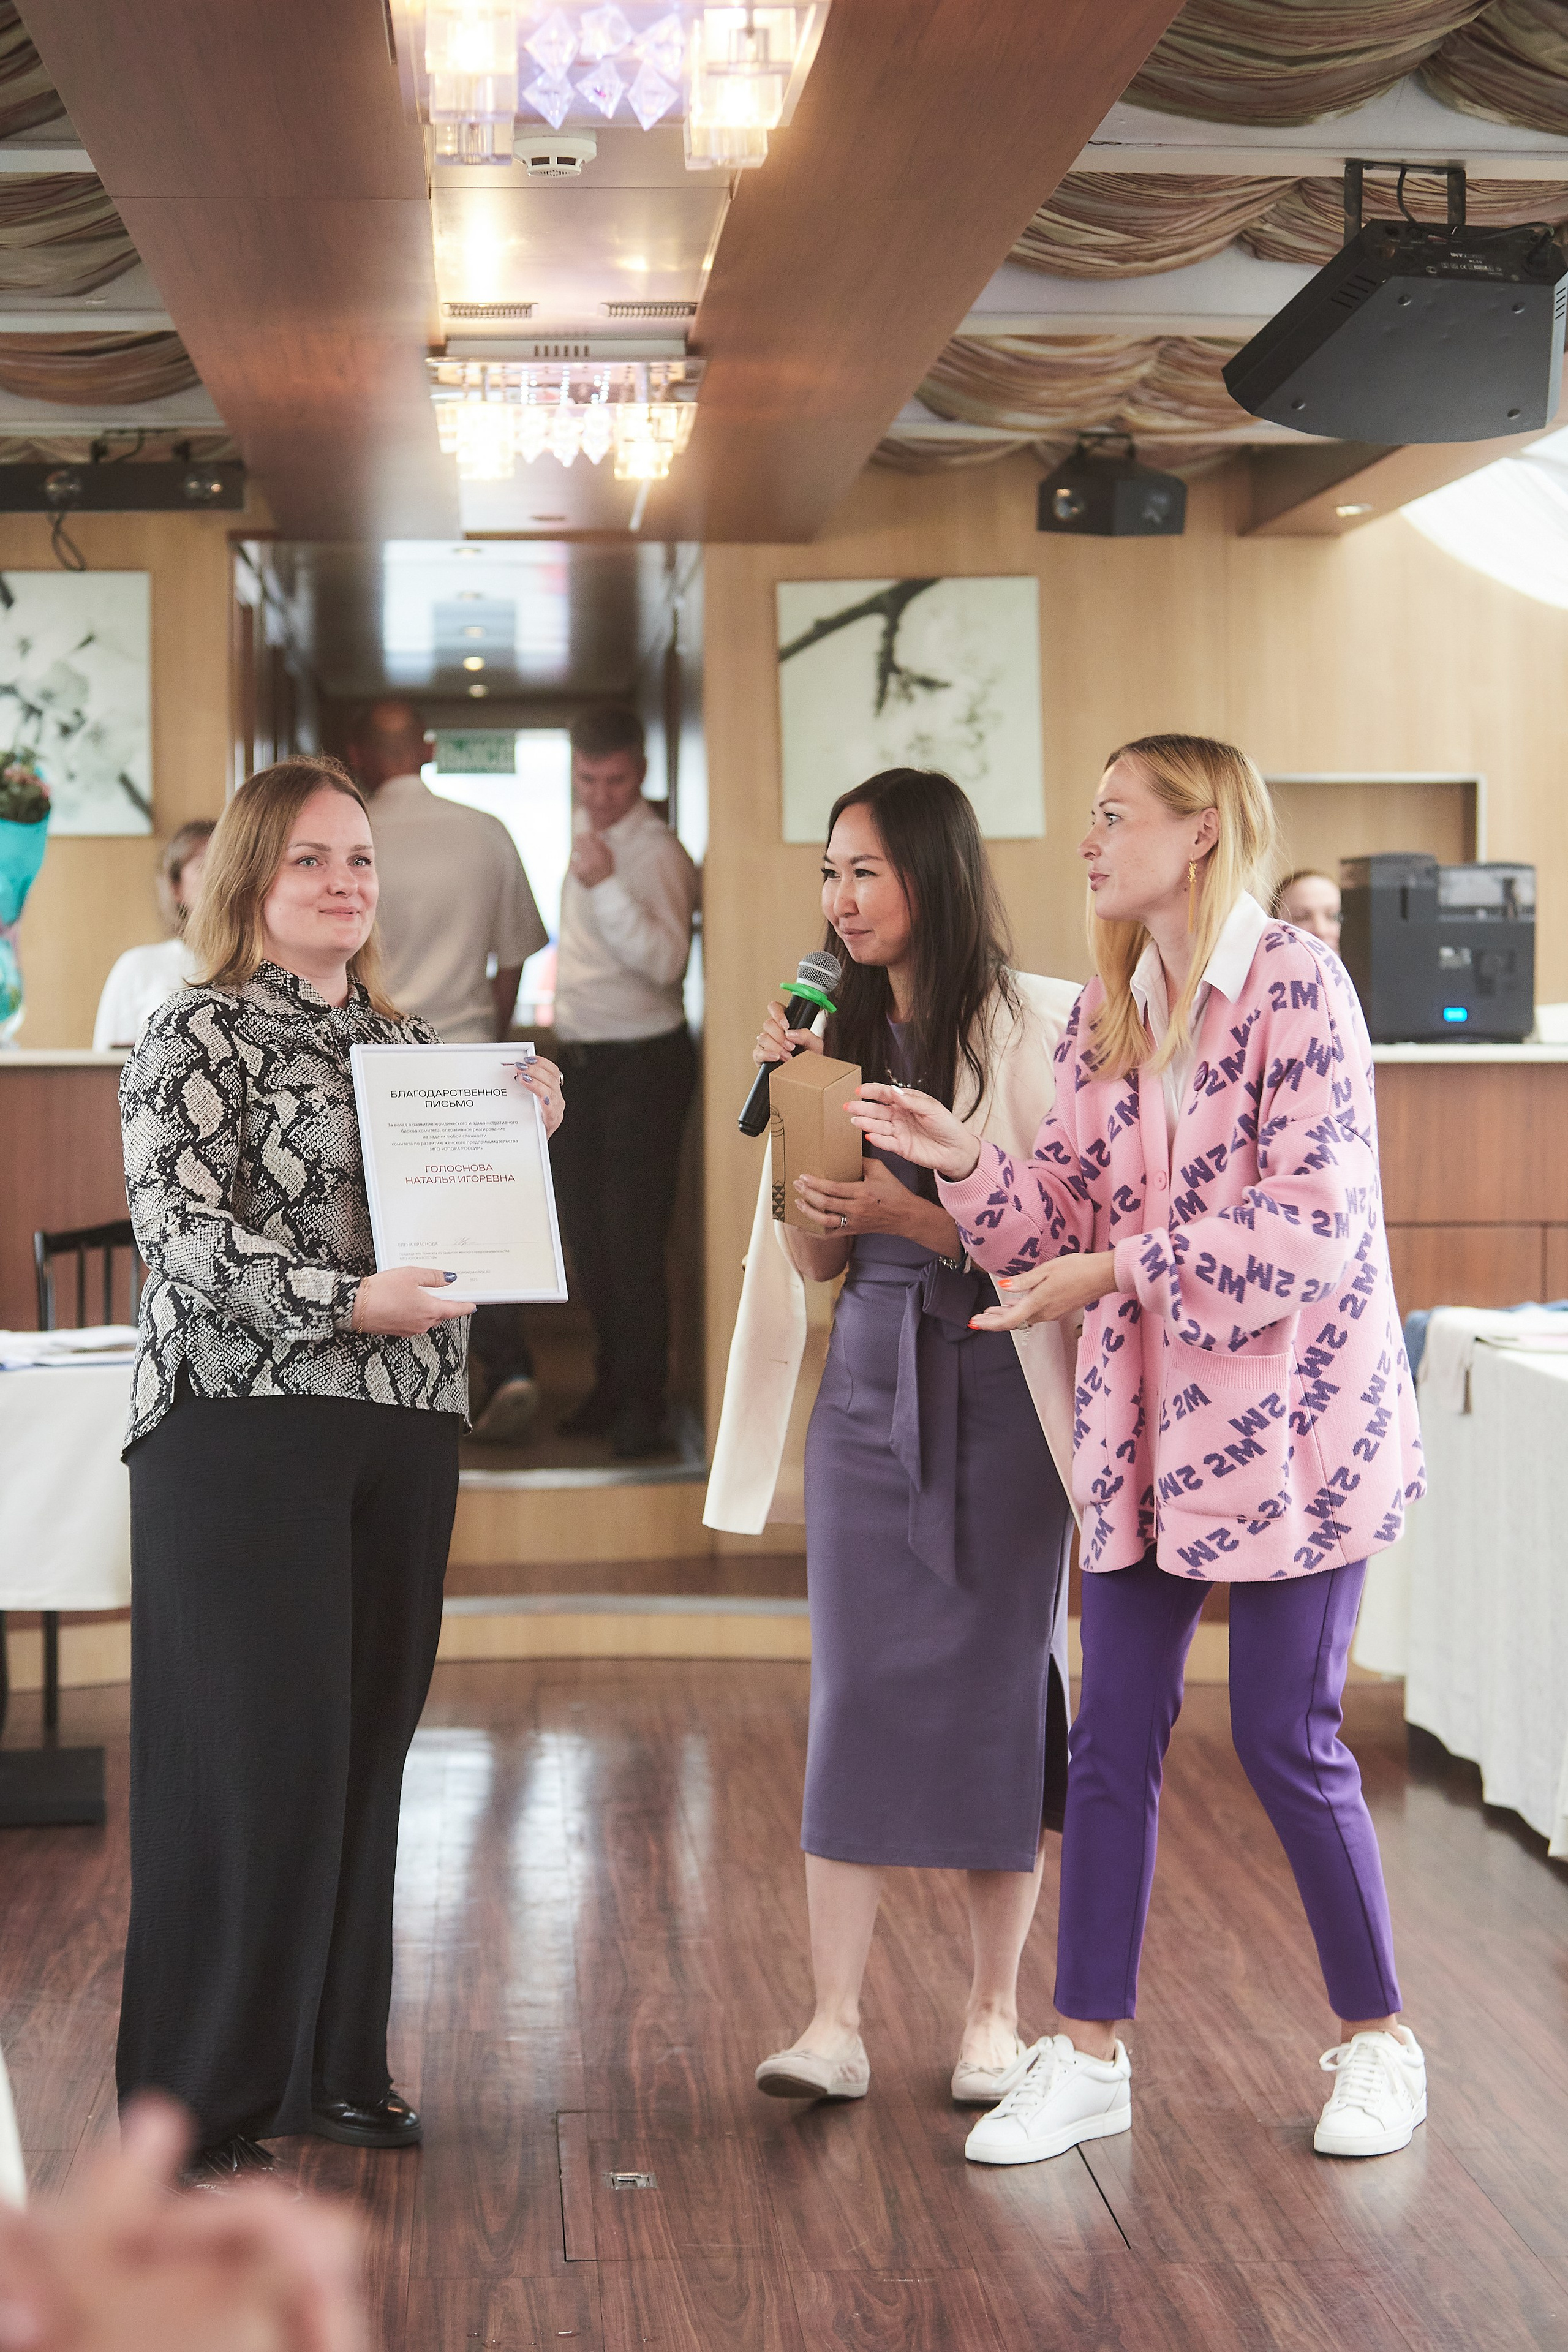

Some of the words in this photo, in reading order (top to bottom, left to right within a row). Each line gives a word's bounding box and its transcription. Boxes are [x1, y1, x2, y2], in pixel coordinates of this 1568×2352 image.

[1268, 981, 1317, 1012] 2M
[390, 1088, 508, 1098] БЛАГОДАРСТВЕННОЕ
[1205, 1049, 1246, 1097] 2M
[425, 1099, 474, 1108] ПИСЬМО
[405, 1175, 456, 1185] НАТАЛЬЯ
[458, 1174, 516, 1183] ИГОРЕВНА
[425, 1164, 494, 1173] ГОЛОСНОВА
[1181, 1143, 1227, 1189] 2M
[1312, 1209, 1349, 1239] 2M
[1196, 1251, 1246, 1304] 2M
[1246, 1254, 1295, 1298] 2M
[1338, 1262, 1378, 1319] 2M
[1294, 1322, 1348, 1379] 2M
[1360, 1349, 1391, 1406] 2M
[1172, 1382, 1212, 1421] 2M
[1228, 1392, 1286, 1438] 2M
[1288, 1378, 1340, 1436] 2M
[1203, 1438, 1268, 1478] 2M
[1352, 1408, 1392, 1463] 2M
[1158, 1464, 1204, 1501] 2M
[1305, 1466, 1360, 1519] 2M
[1373, 1488, 1404, 1542] 2M
[1091, 1521, 1115, 1562] 2M
[1177, 1527, 1240, 1567] 2M
[1294, 1519, 1352, 1570] 2M
